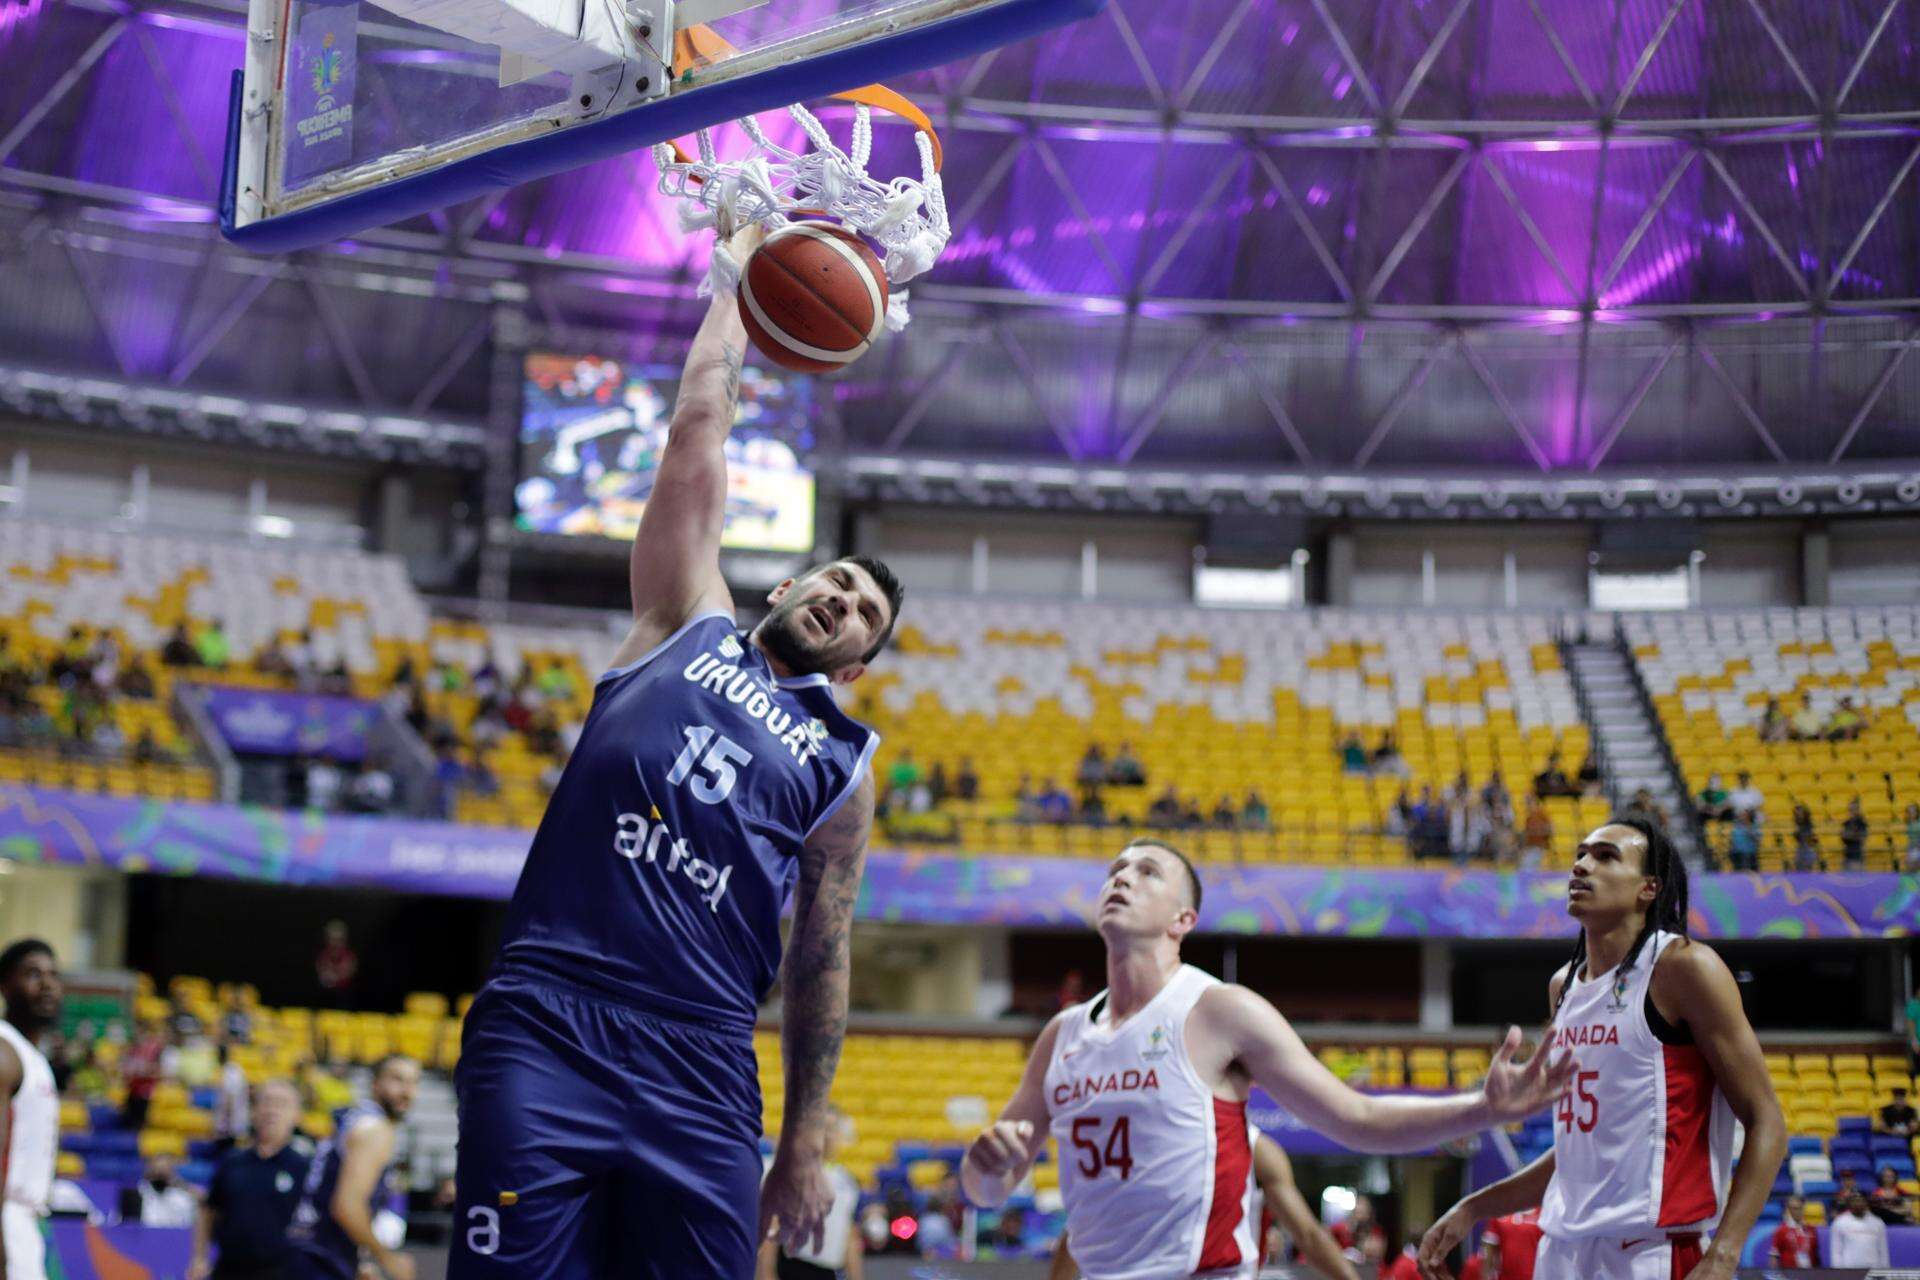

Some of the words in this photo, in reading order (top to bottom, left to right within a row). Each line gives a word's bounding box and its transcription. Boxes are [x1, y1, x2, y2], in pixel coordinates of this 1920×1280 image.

[683, 652, 823, 767] URUGUAY
[666, 725, 753, 805] 15
[1053, 1069, 1160, 1105] CANADA
[1558, 1070, 1600, 1135] 45
[1070, 1115, 1134, 1181] 54
